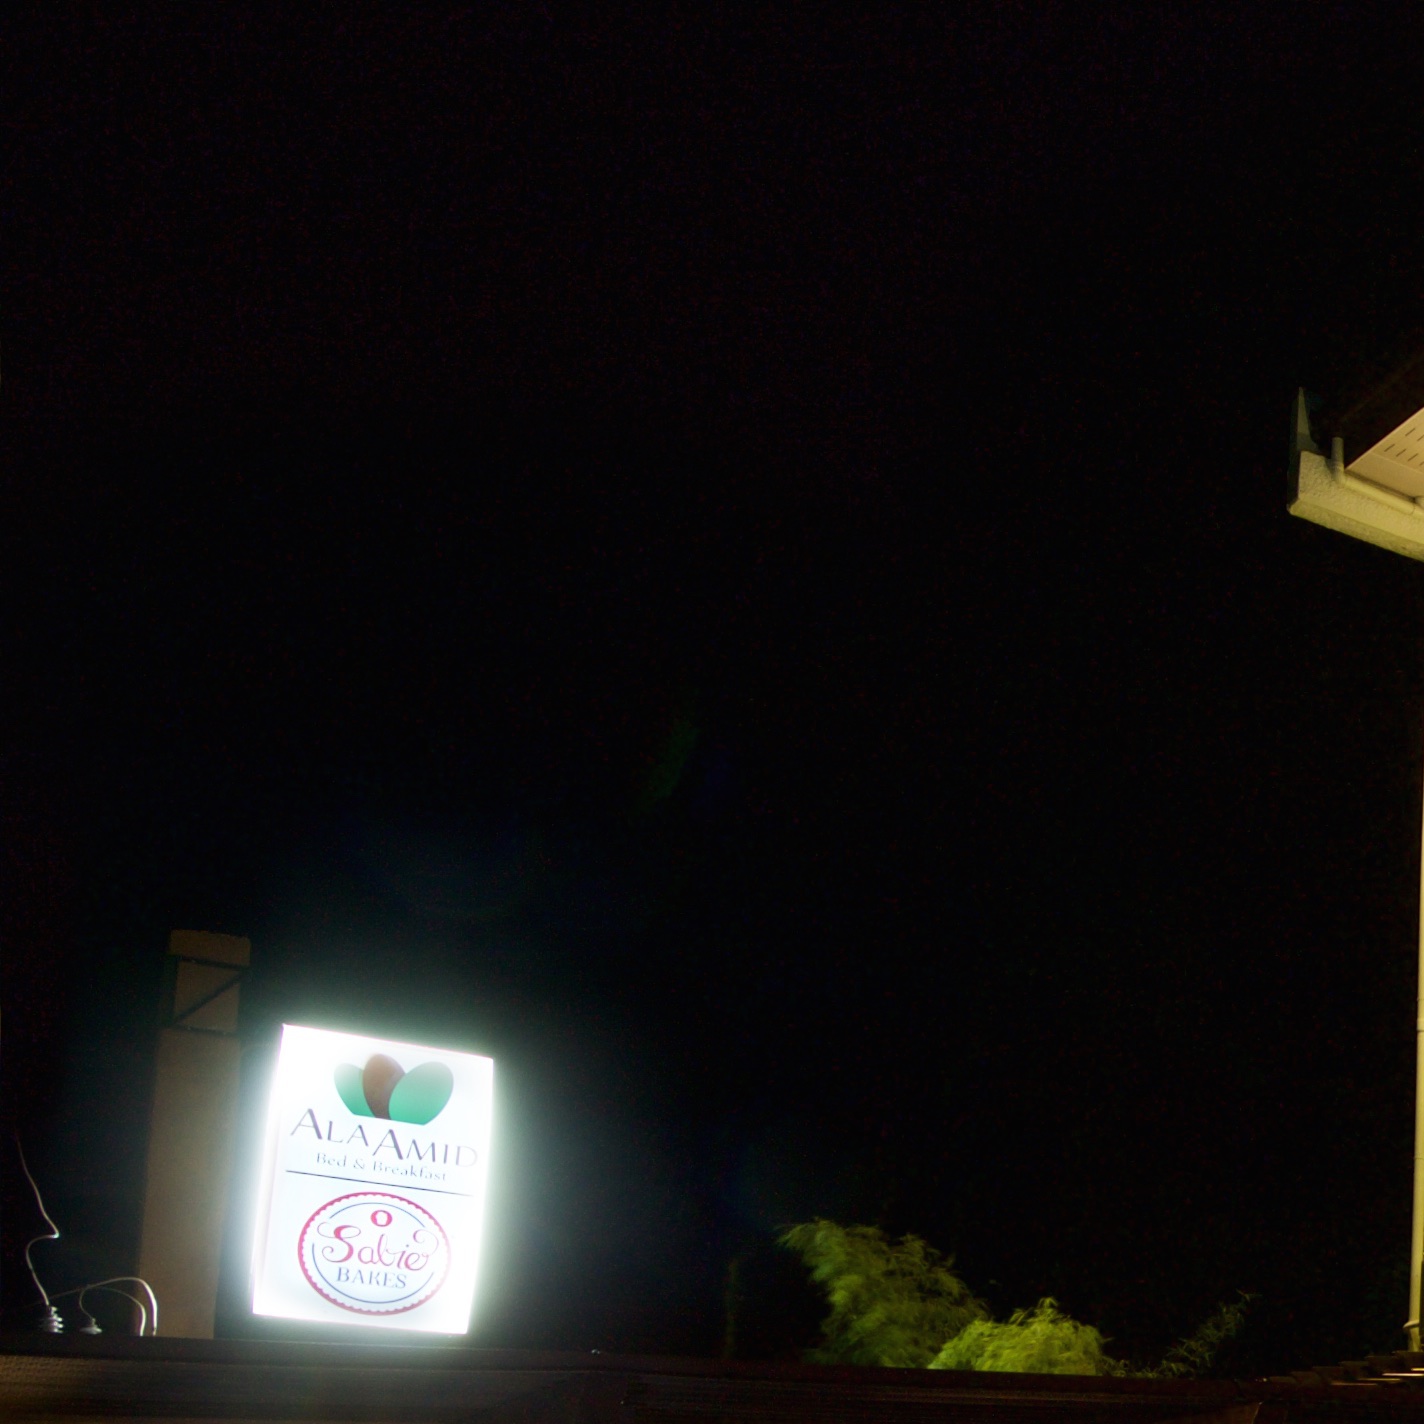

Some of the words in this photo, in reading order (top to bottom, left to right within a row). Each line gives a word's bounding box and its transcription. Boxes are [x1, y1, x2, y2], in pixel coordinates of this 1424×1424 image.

[316, 1152, 347, 1168] Bed
[353, 1158, 366, 1171] &
[373, 1161, 447, 1181] Breakfast
[337, 1266, 407, 1289] BAKES
